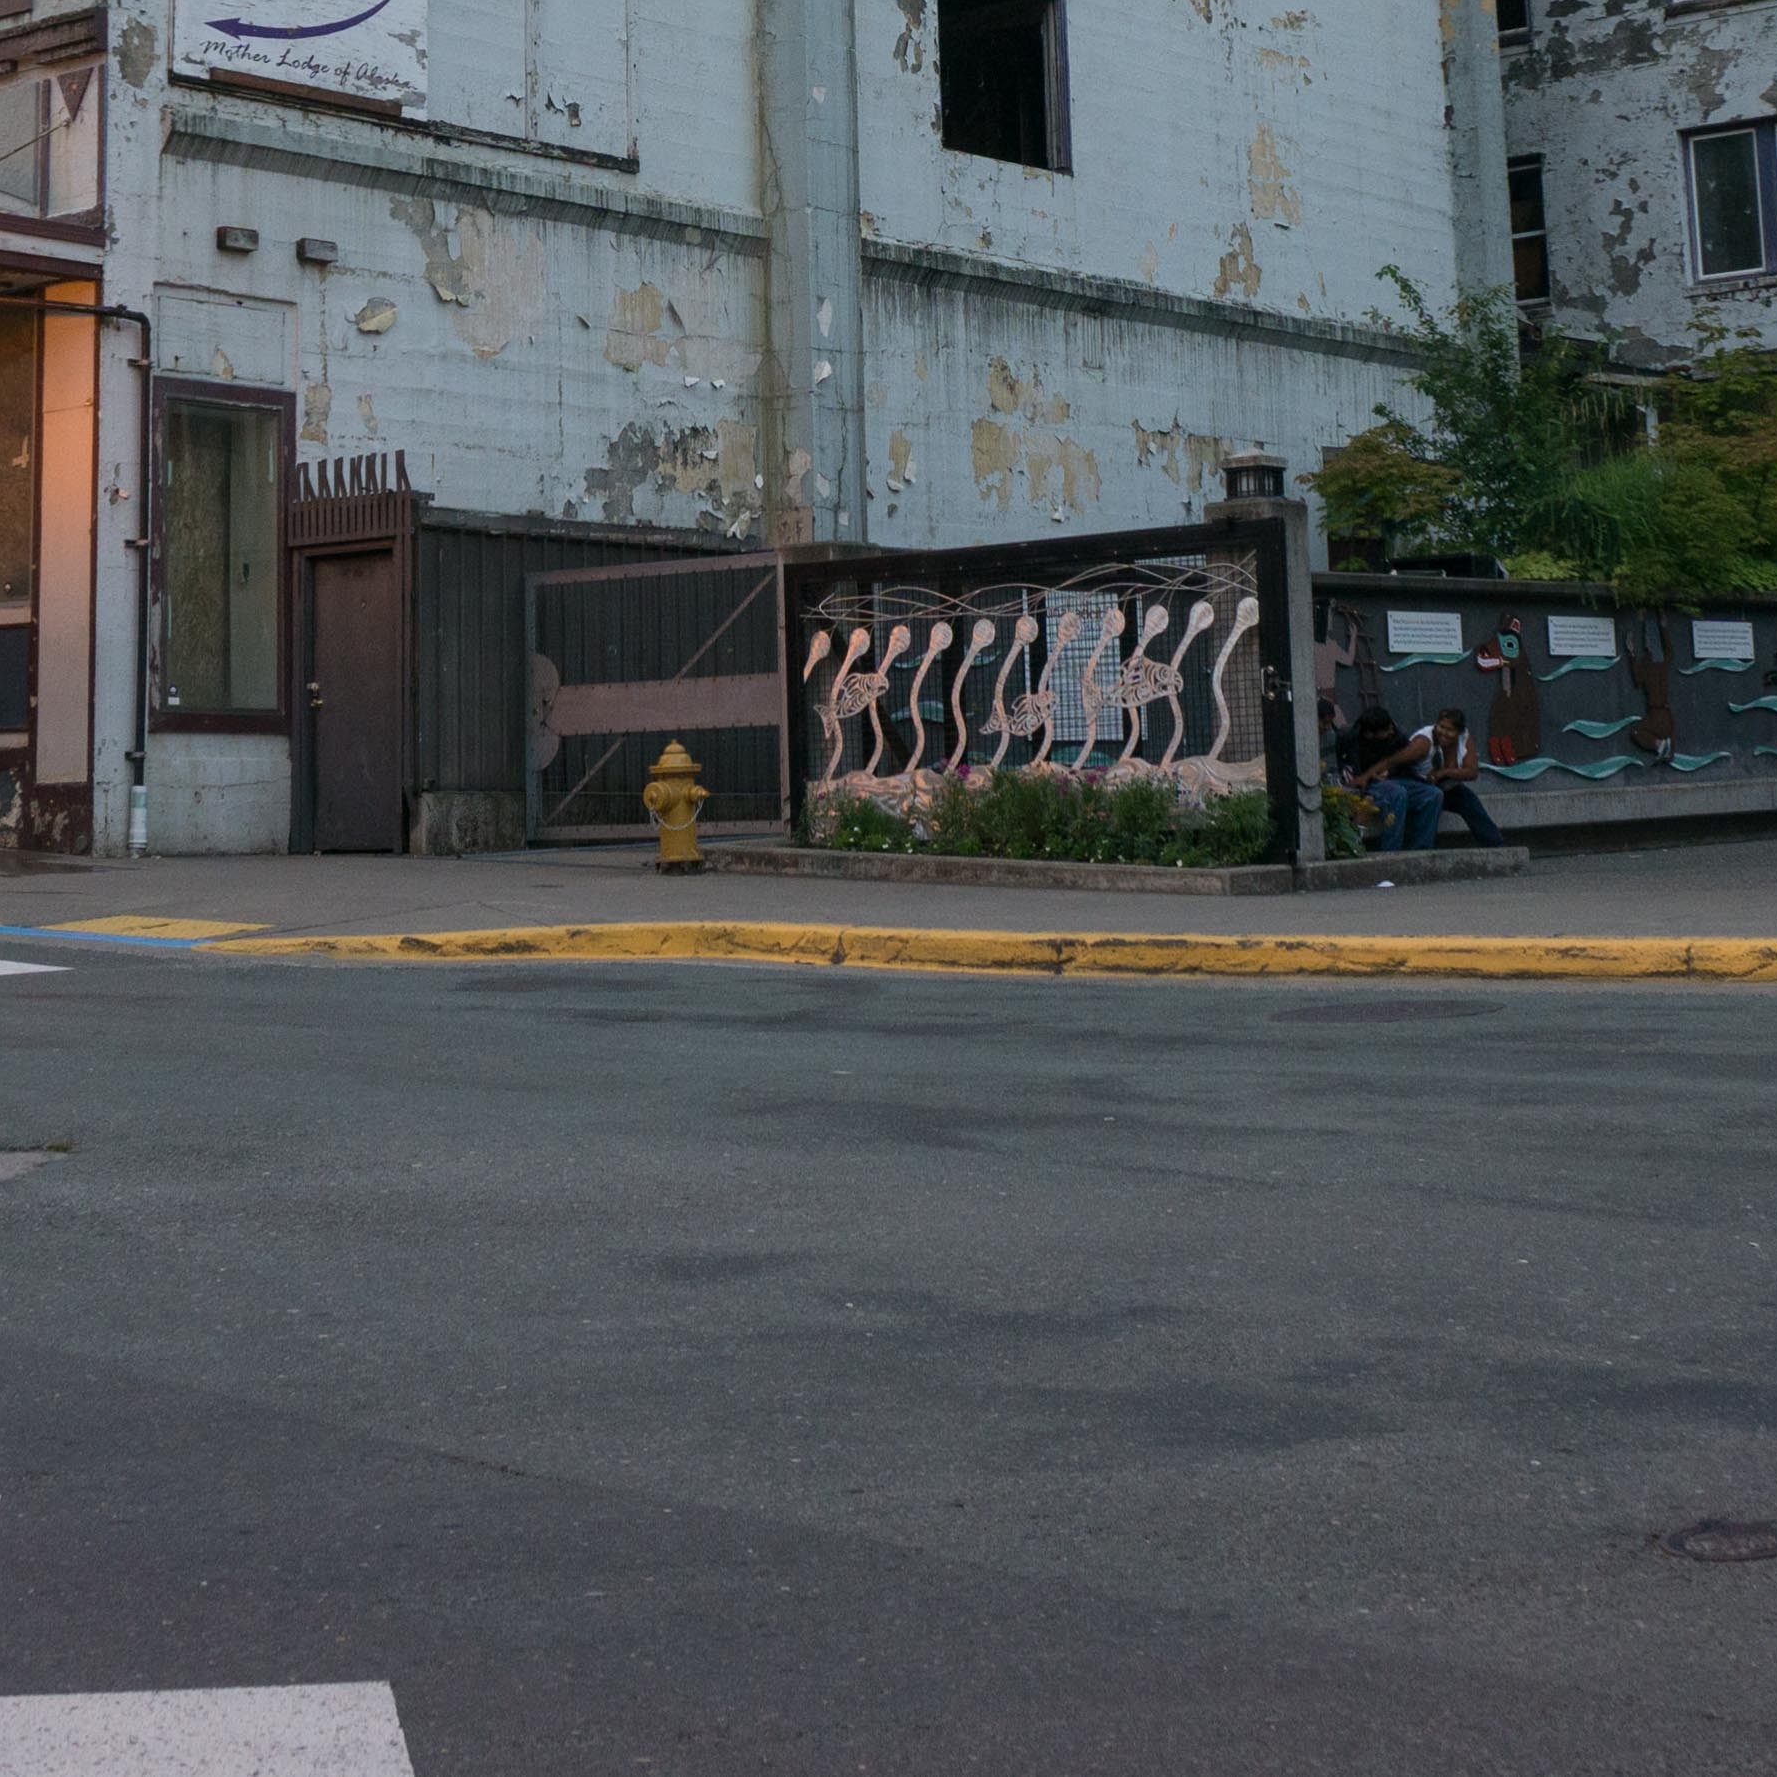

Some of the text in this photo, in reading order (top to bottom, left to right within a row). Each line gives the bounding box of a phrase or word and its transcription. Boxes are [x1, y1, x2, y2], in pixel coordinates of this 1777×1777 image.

[199, 38, 271, 65] Mother
[275, 48, 330, 79] Lodge
[334, 62, 353, 86] of
